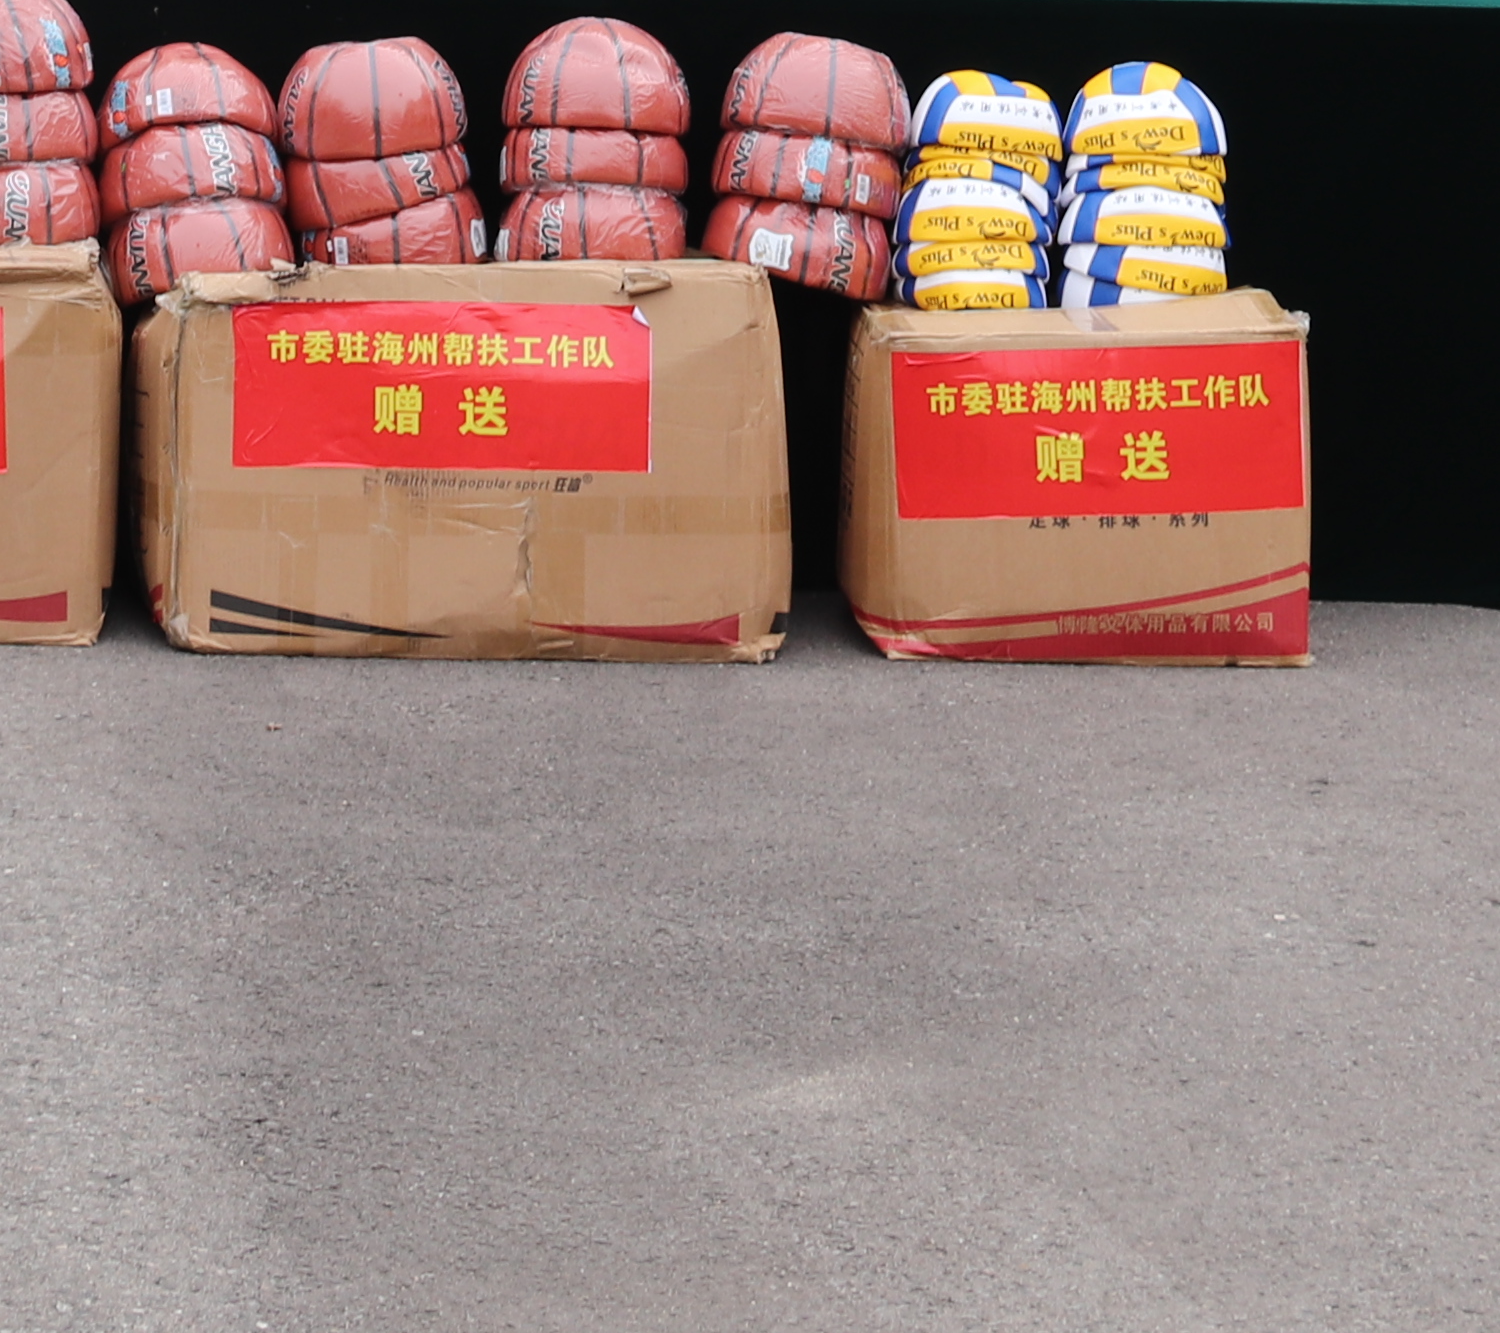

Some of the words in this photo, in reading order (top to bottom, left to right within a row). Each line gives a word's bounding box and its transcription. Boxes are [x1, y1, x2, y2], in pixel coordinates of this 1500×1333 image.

[268, 330, 616, 368] 市委驻海州帮扶工作队
[926, 374, 1270, 418] 市委驻海州帮扶工作队
[384, 471, 428, 487] Health
[432, 475, 456, 488] and
[459, 475, 512, 492] popular
[515, 478, 550, 492] sport
